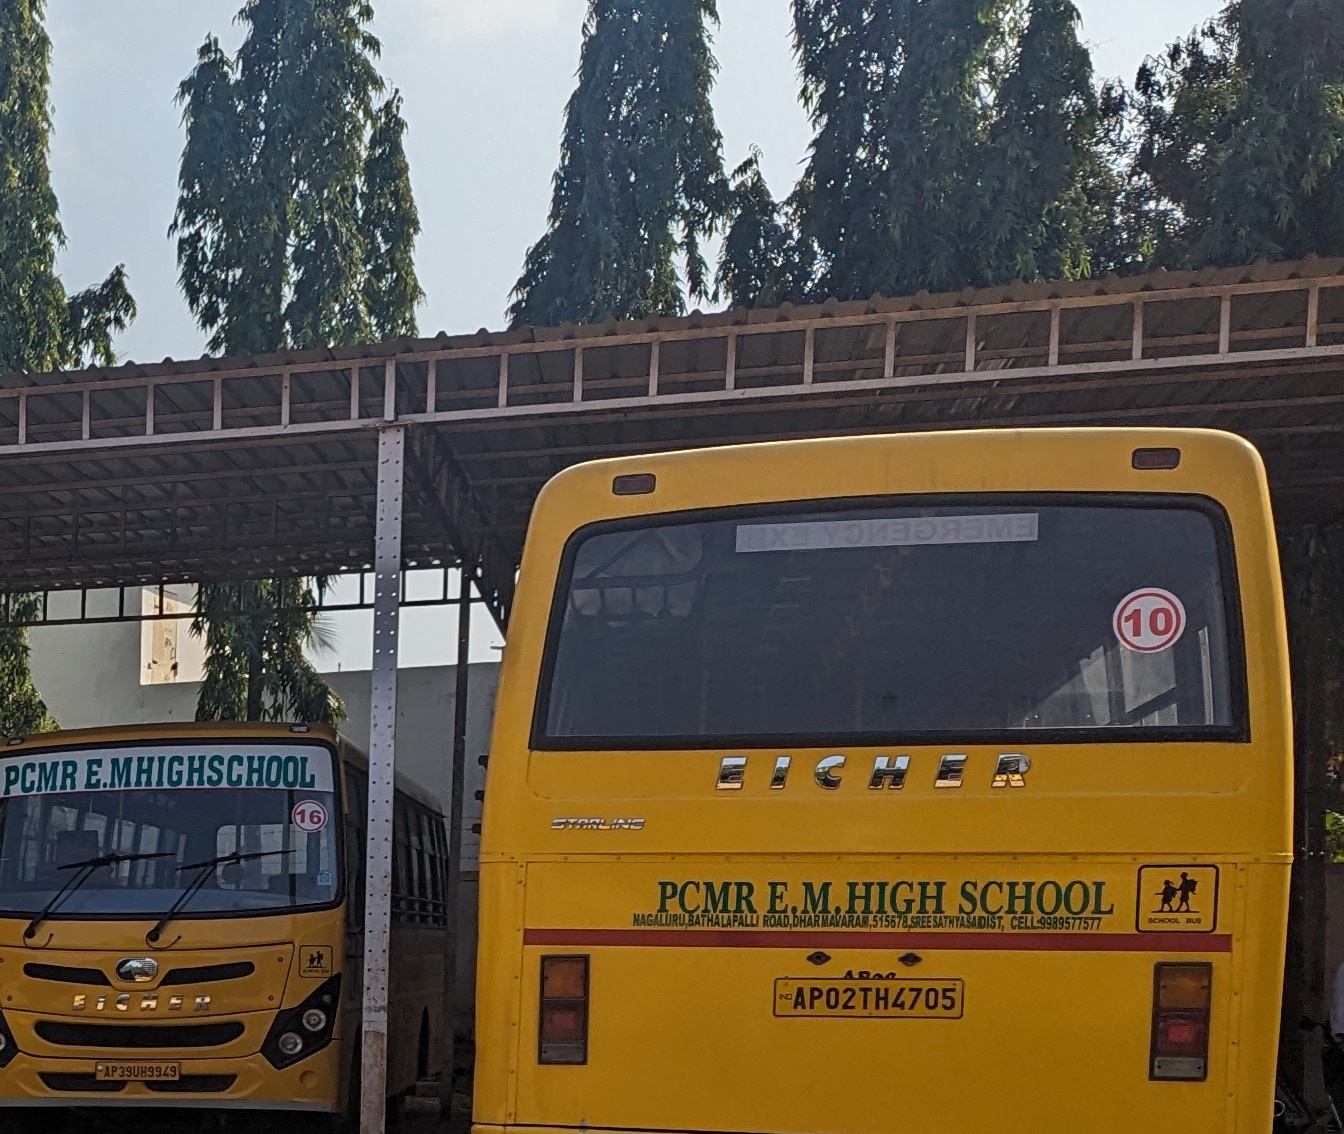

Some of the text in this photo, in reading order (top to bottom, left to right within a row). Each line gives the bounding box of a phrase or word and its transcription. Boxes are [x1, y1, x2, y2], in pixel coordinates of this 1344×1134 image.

[1124, 607, 1174, 638] 10
[3, 759, 78, 796] PCMR
[716, 753, 1032, 790] EICHER
[295, 808, 322, 825] 16
[550, 817, 646, 831] STARLINE
[656, 880, 758, 915] PCMR
[958, 880, 1115, 916] SCHOOL
[72, 993, 212, 1012] EICHER
[778, 986, 957, 1011] IND AP02TH4705
